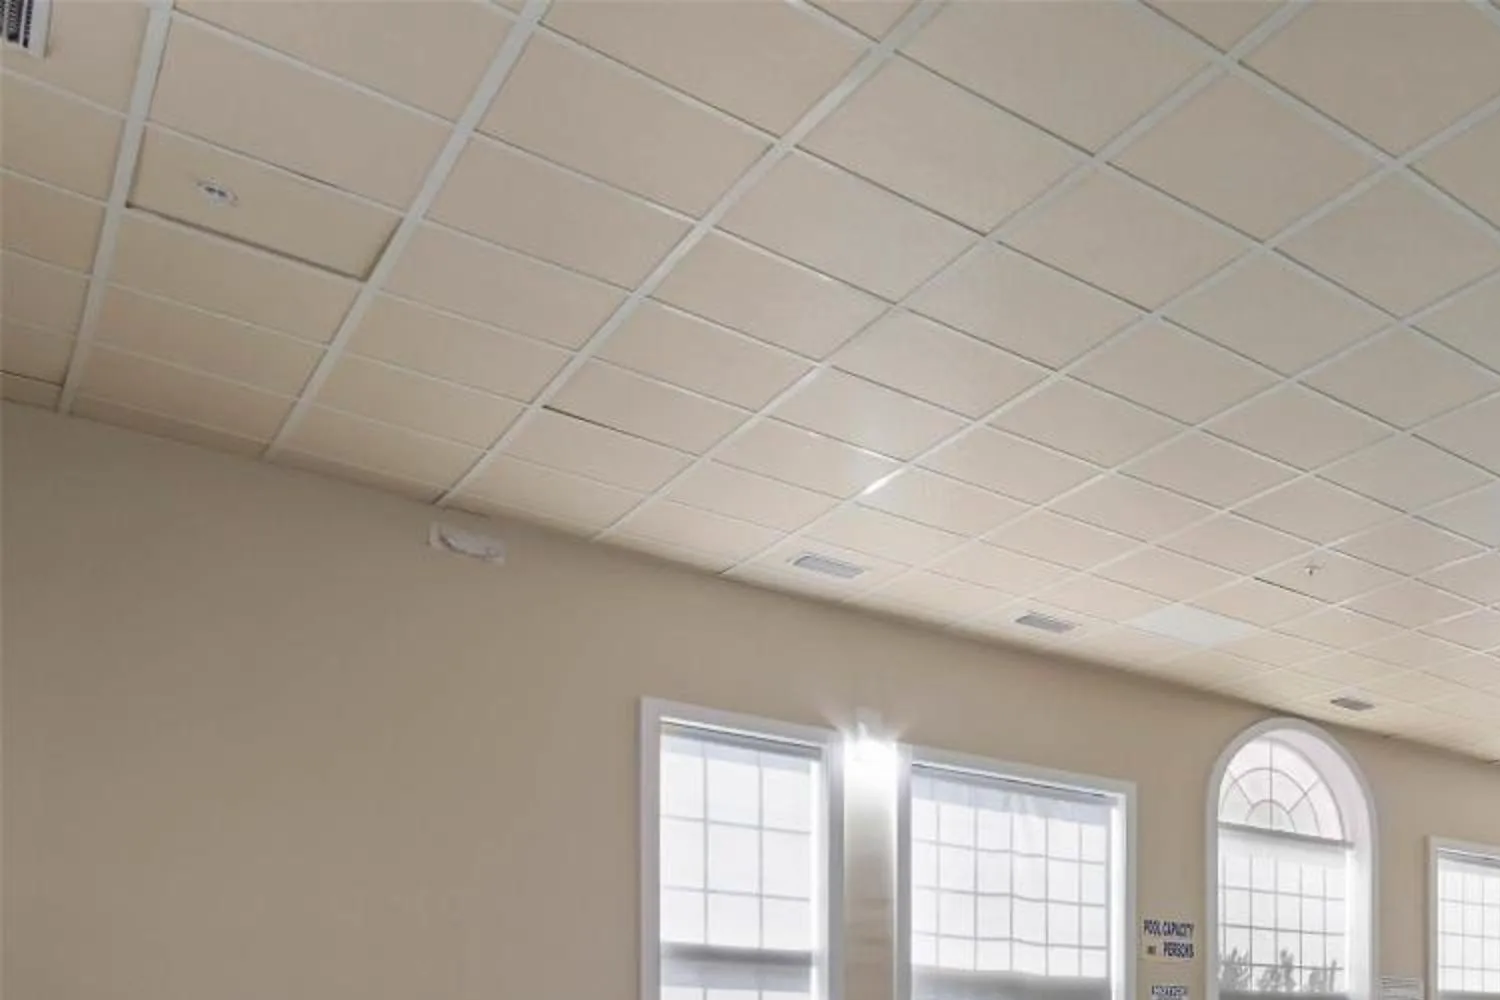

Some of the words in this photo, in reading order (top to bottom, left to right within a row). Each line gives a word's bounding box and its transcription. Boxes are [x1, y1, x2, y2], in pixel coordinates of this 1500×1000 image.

[1143, 919, 1161, 935] POOL
[1163, 921, 1194, 937] CAPACITY
[1163, 942, 1194, 958] PERSONS
